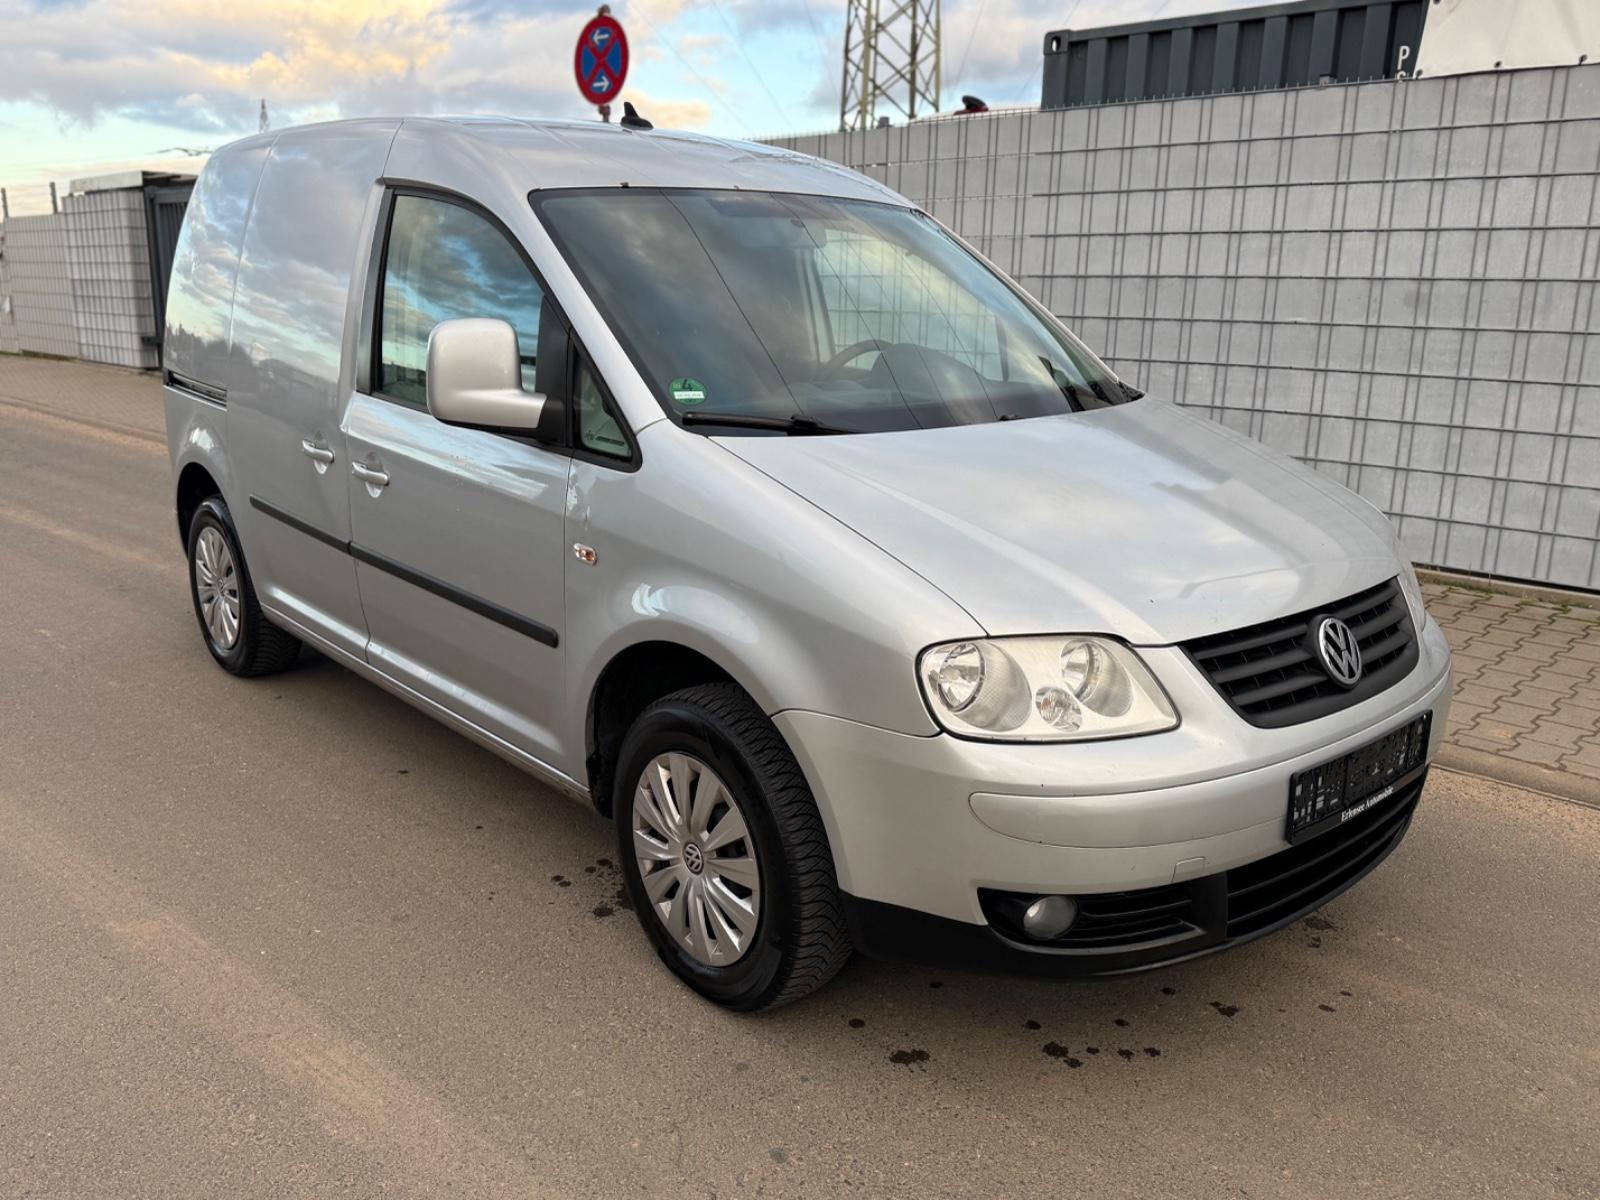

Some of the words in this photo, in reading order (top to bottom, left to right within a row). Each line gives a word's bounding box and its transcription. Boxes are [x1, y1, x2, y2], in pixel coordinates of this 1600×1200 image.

[1397, 45, 1410, 70] P
[1320, 618, 1361, 684] VW
[1365, 785, 1394, 809] Automobile
